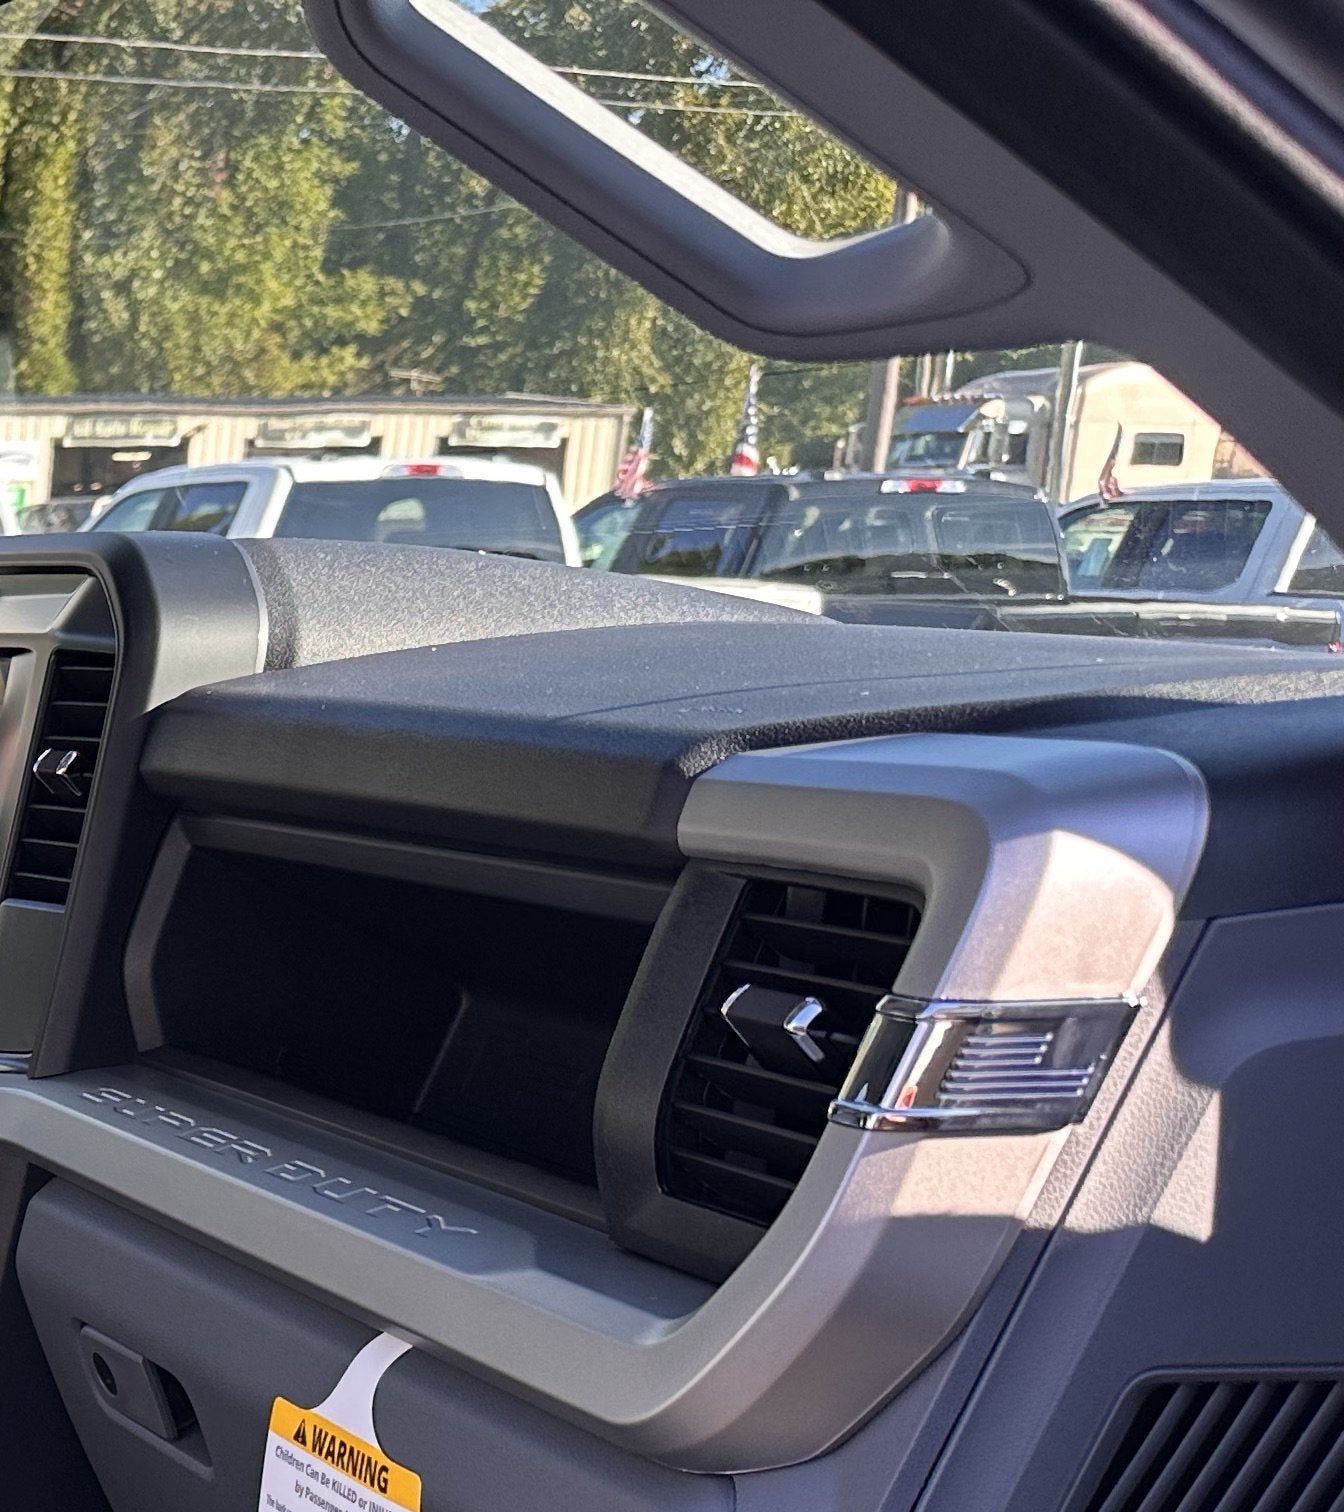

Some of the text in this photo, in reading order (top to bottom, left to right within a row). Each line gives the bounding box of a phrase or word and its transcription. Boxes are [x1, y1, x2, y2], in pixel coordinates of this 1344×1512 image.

[81, 1086, 479, 1238] SUPER DUTY
[275, 1445, 305, 1473] Children
[306, 1463, 320, 1483] Can
[320, 1472, 331, 1489] Be
[331, 1478, 358, 1504] KILLED
[358, 1497, 368, 1511] or
[294, 1479, 305, 1498] by
[312, 1424, 389, 1495] WARNING
